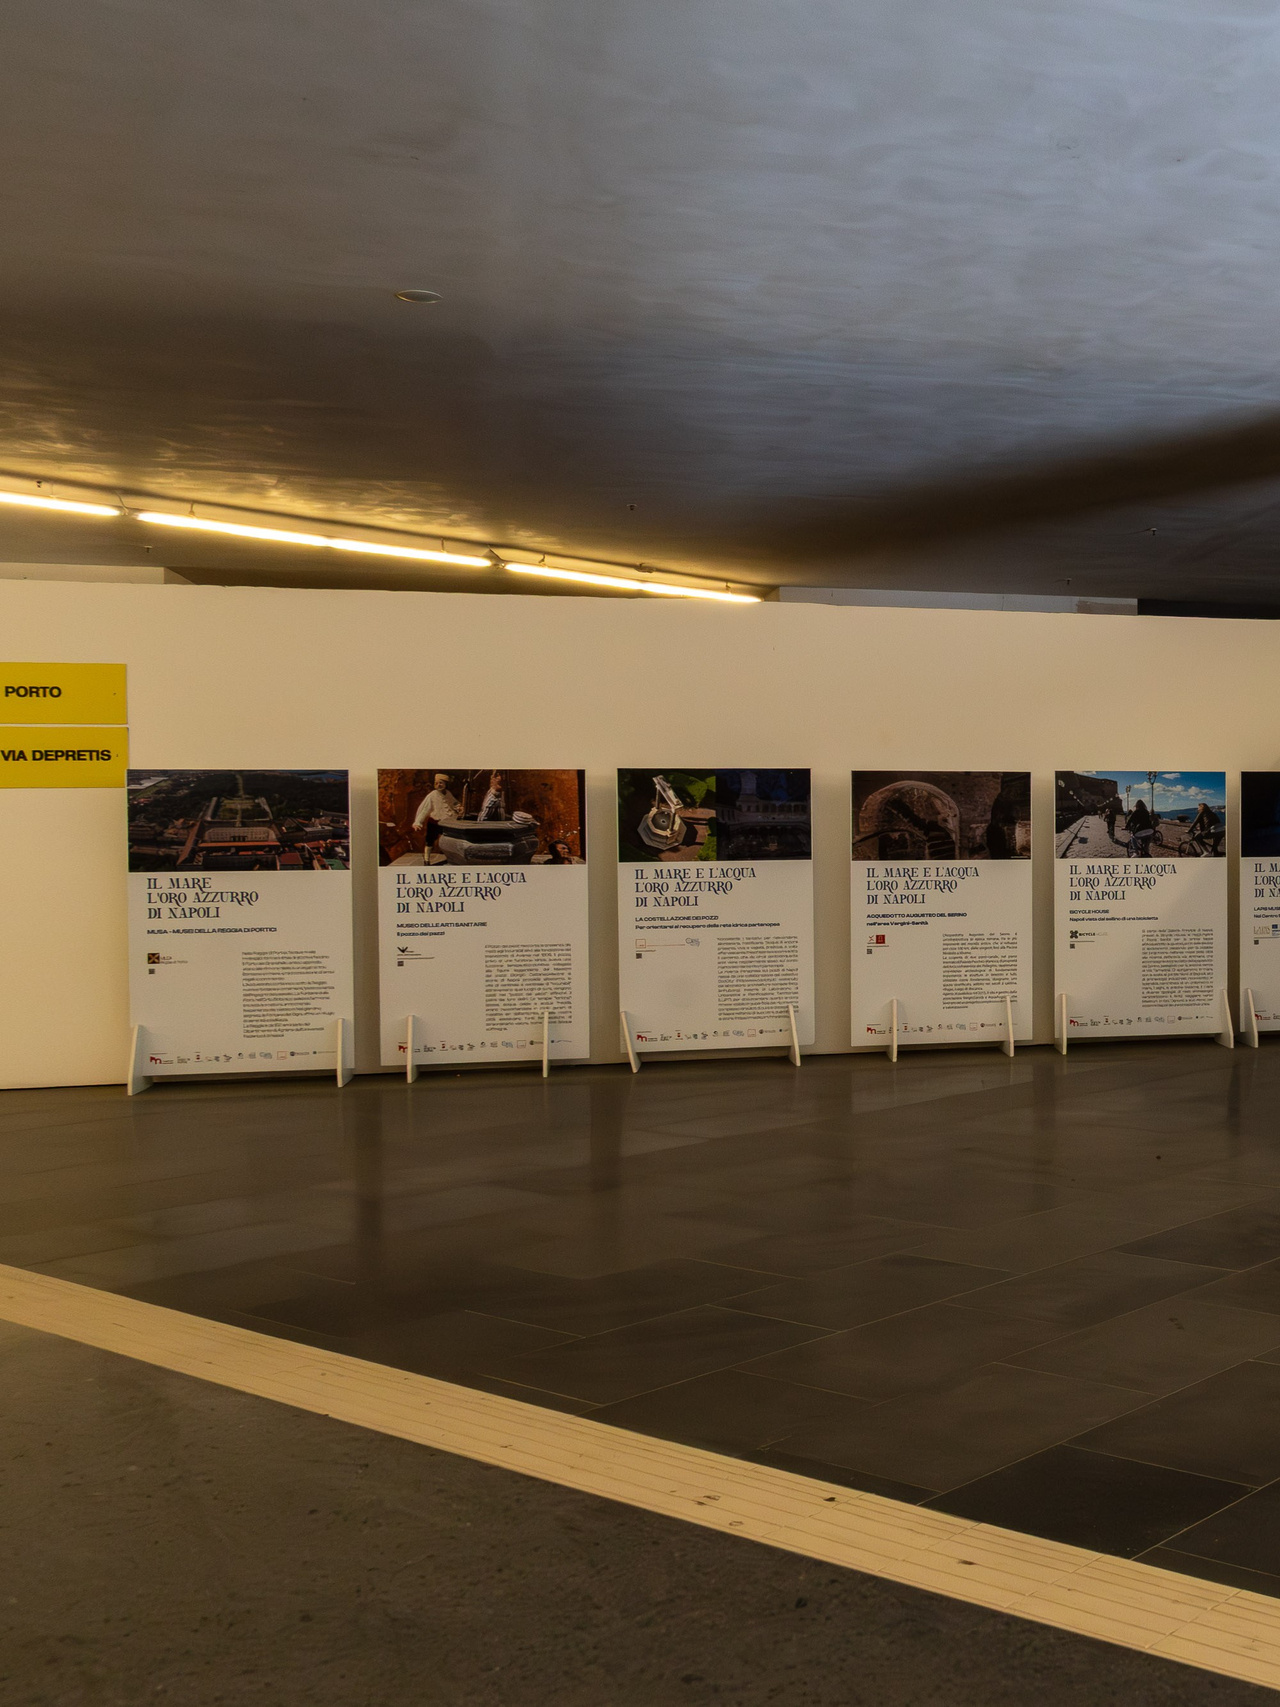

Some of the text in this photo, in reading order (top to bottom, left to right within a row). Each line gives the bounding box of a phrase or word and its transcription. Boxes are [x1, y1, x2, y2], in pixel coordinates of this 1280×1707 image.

[5, 686, 62, 698] PORTO
[0, 750, 112, 761] VIA DEPRETIS
[866, 867, 979, 881] IL MARE E L'ACQUA
[1069, 864, 1177, 878] IL MARE E L'ACQUA
[1254, 863, 1265, 873] IL
[396, 872, 527, 888] IL MARE E L'ACQUA
[635, 867, 756, 883] IL MARE E L'ACQUA
[147, 877, 212, 893] IL MARE
[635, 881, 733, 896] L'ORO AZZURRO
[866, 880, 957, 893] L'ORO AZZURRO
[1069, 876, 1156, 890] L'ORO AZZURRO
[147, 891, 259, 907] L'ORO AZZURRO
[396, 886, 502, 901] L'ORO AZZURRO
[866, 894, 925, 904] DI NAPOLI
[1070, 890, 1125, 901] DI NAPOLI
[1254, 888, 1264, 897] DI
[397, 902, 464, 913] DI NAPOLI
[635, 896, 698, 907] DI NAPOLI
[147, 907, 220, 919] DI NAPOLI
